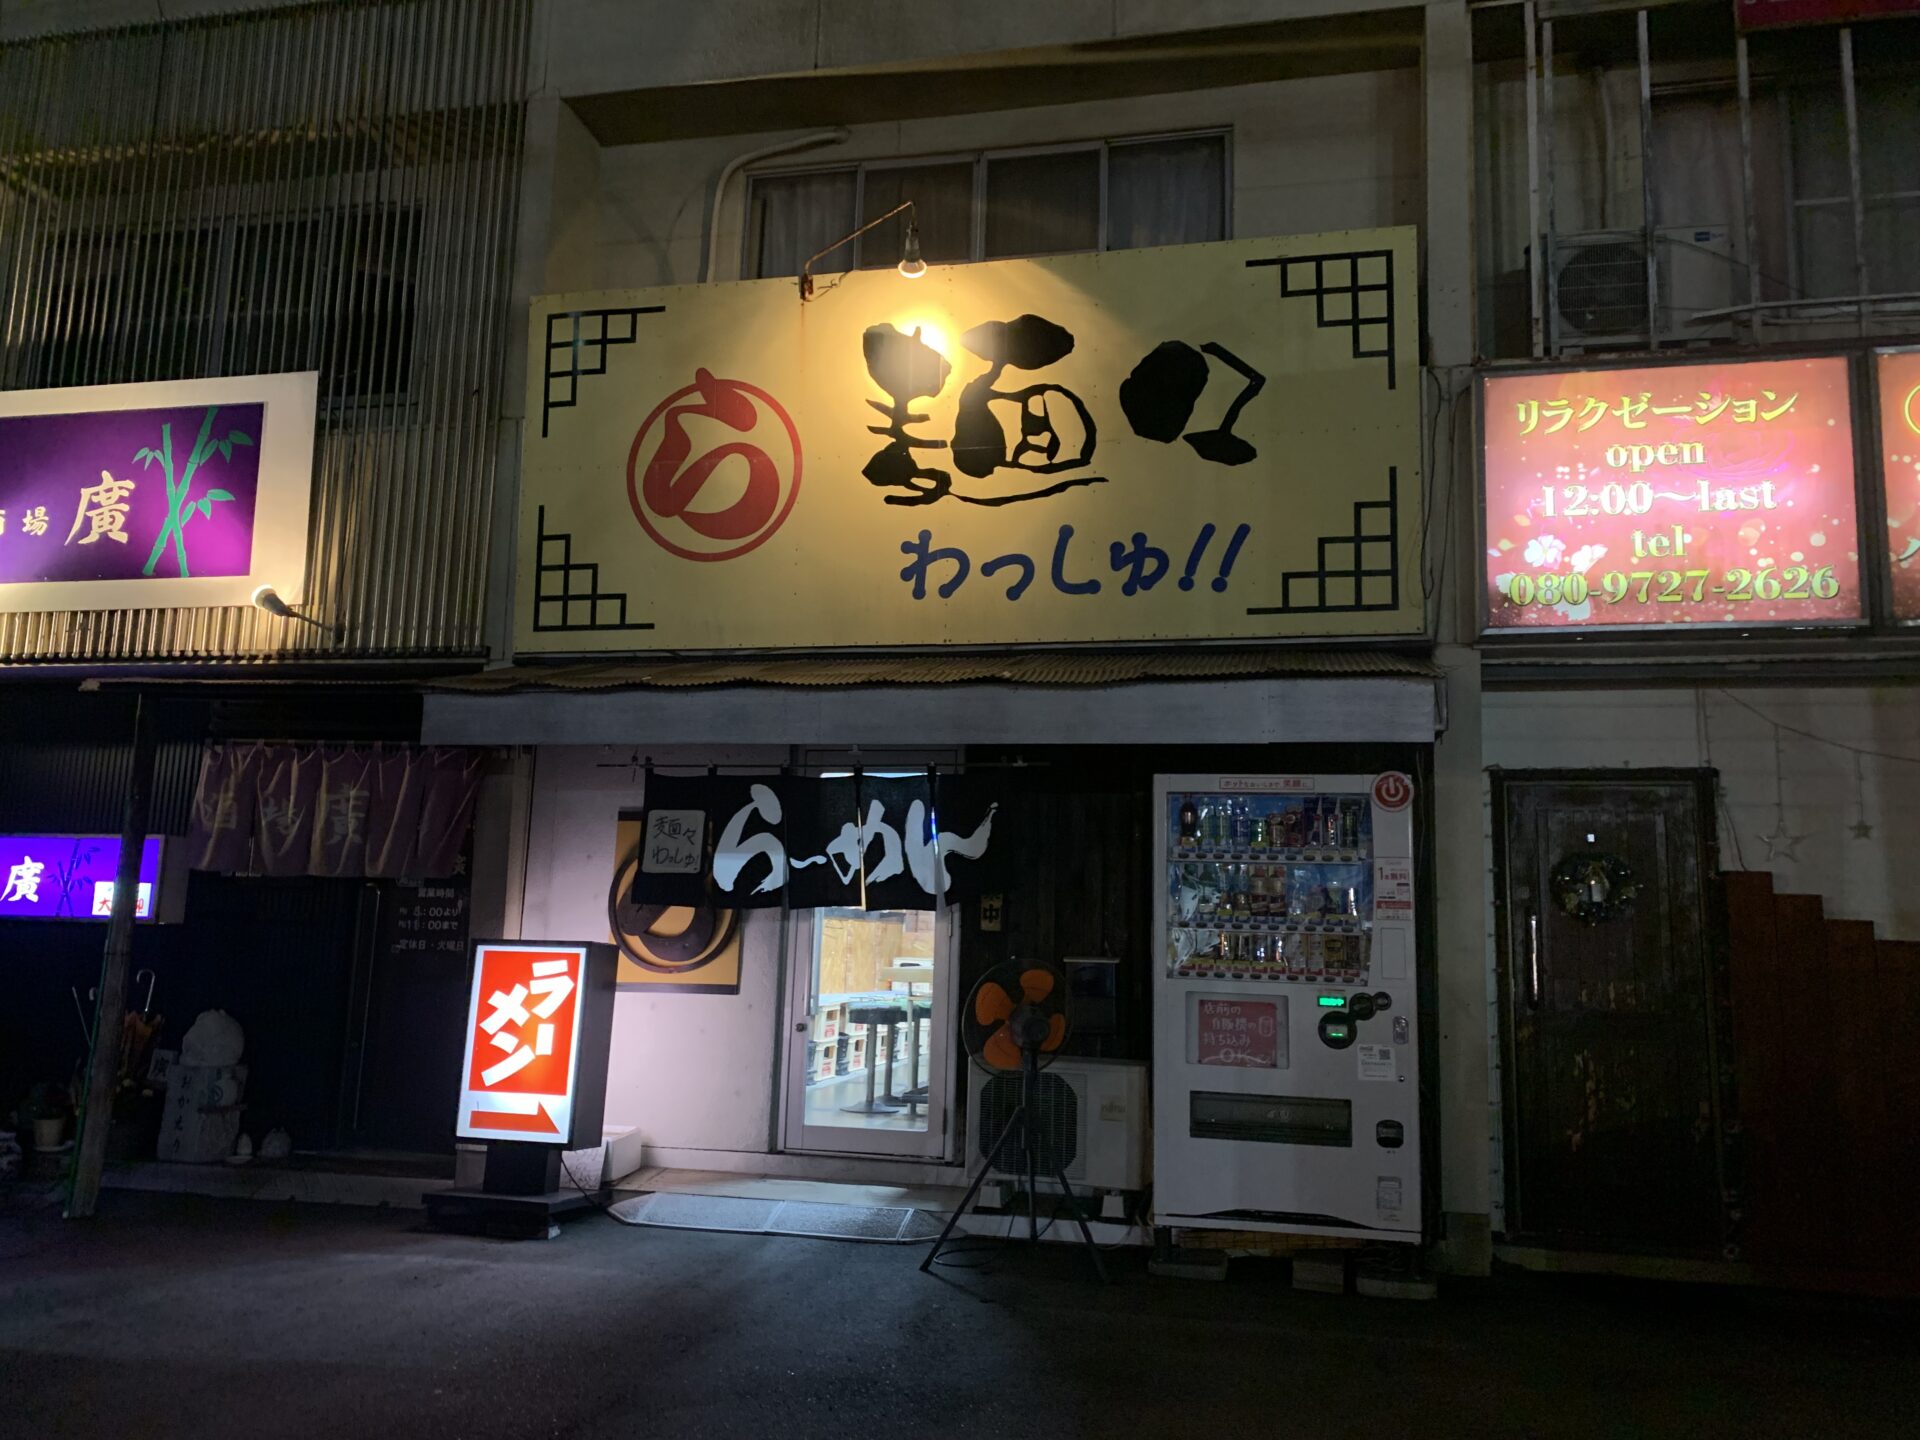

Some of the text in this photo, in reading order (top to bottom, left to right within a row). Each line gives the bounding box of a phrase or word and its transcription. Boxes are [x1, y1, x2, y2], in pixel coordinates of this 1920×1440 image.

[1515, 390, 1799, 436] リラクゼーション
[1604, 441, 1706, 473] open
[899, 522, 1252, 602] わっしゅ!!
[1631, 524, 1688, 559] tel
[1508, 563, 1840, 607] 080-9727-2626
[653, 815, 697, 846] 麺々
[712, 783, 1000, 897] らーめん
[0, 855, 45, 903] 廣
[479, 959, 575, 1088] ラーメン
